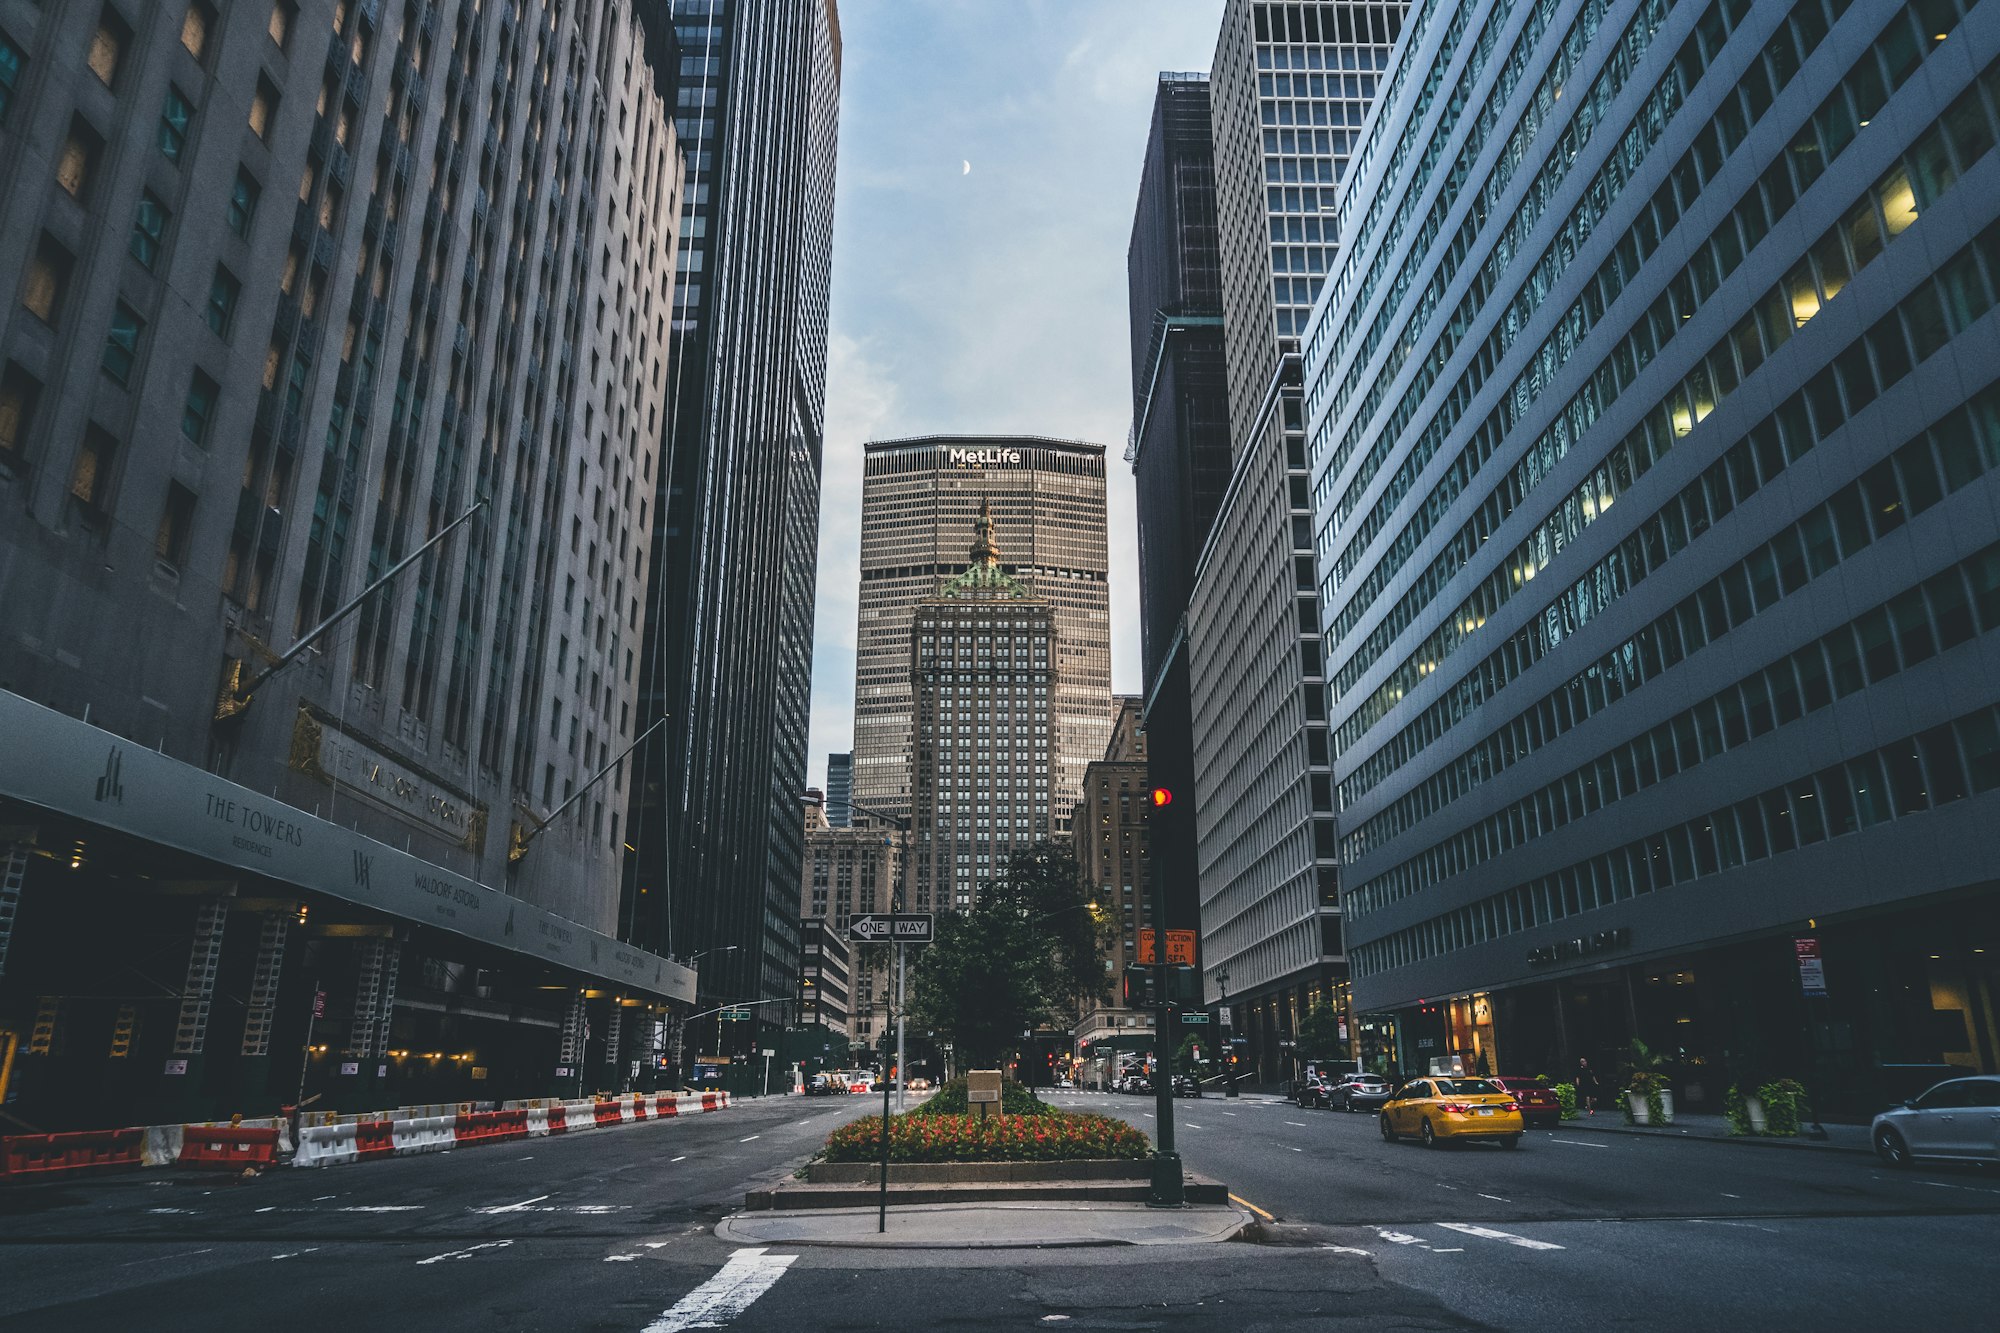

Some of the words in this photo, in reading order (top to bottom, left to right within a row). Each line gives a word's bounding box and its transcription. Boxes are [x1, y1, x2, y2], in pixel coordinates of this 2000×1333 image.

[950, 448, 1021, 464] MetLife
[206, 793, 235, 823] THE
[242, 806, 302, 847] TOWERS
[232, 835, 272, 858] RESIDENCES
[414, 871, 452, 900] WALDORF
[453, 889, 480, 910] ASTORIA
[860, 922, 885, 933] ONE
[898, 922, 925, 933] WAY
[1142, 933, 1191, 942] CONUCTION
[1173, 944, 1184, 952] ST
[1148, 954, 1186, 963] CSED
